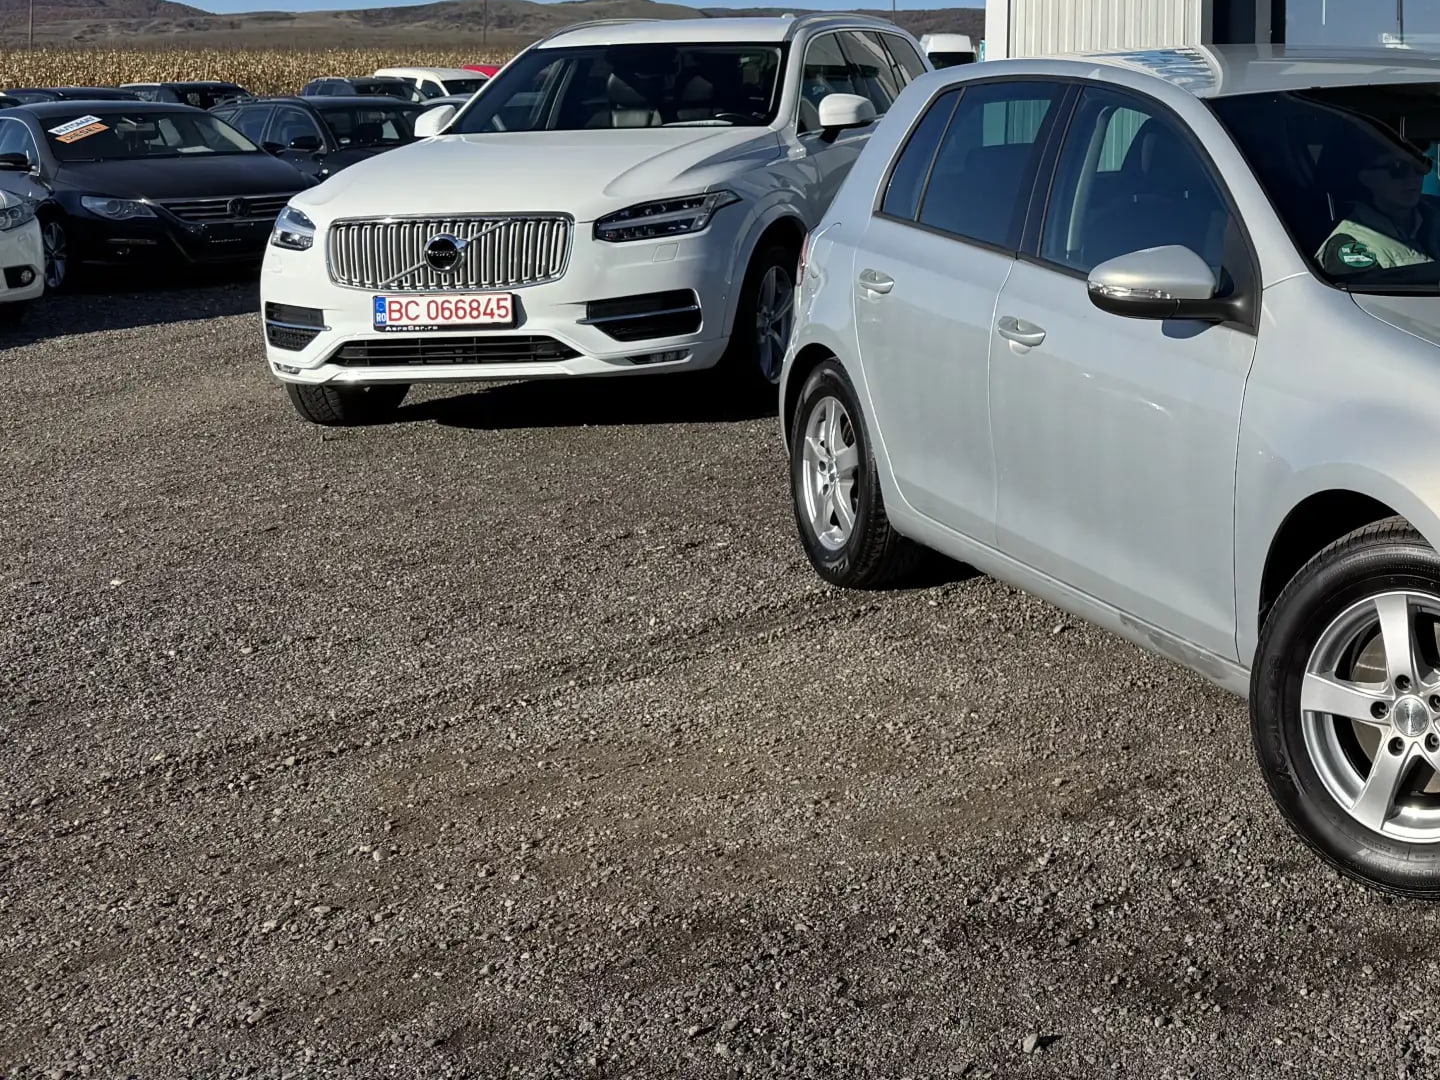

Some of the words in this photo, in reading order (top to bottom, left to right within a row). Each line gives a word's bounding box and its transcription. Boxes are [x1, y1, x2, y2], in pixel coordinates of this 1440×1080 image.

[376, 313, 387, 323] RO
[388, 300, 420, 322] BC
[427, 298, 510, 321] 066845
